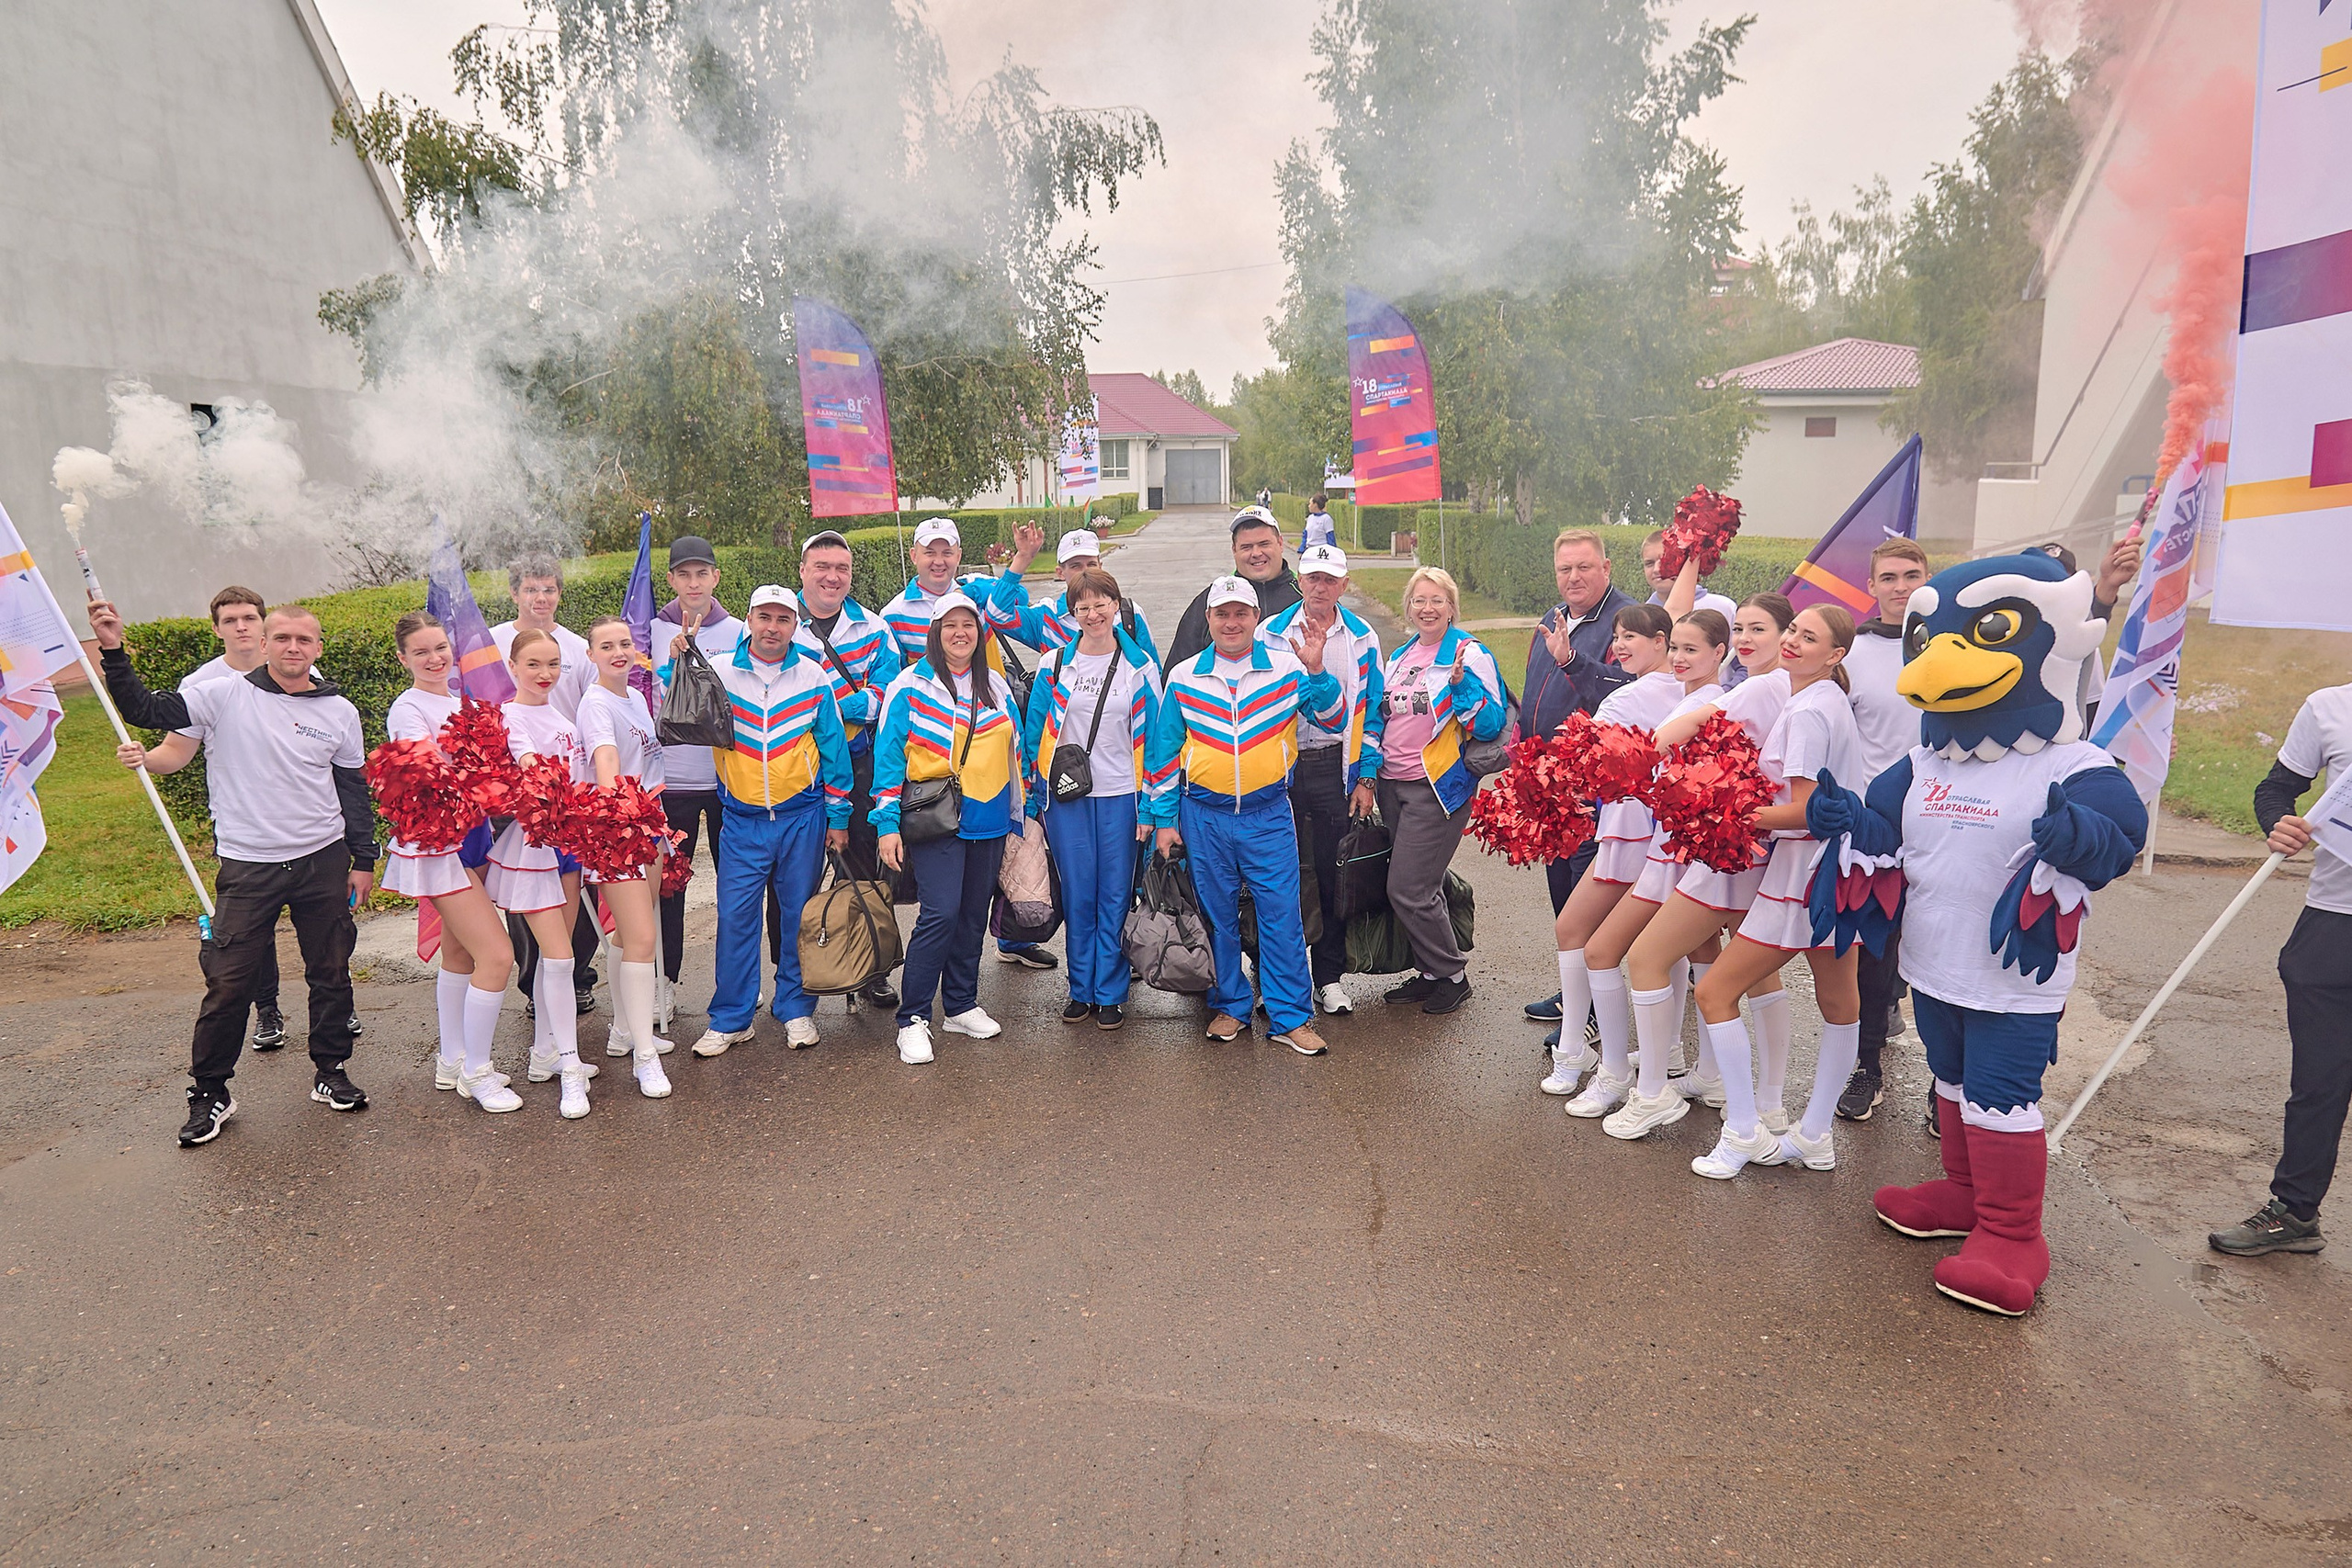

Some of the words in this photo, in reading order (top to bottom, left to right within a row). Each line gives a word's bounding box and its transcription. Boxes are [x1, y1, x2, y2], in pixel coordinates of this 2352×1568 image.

[1363, 378, 1377, 394] 18
[1317, 547, 1329, 560] LA
[1057, 781, 1080, 795] adidas
[1946, 795, 1991, 806] ОТРАСЛЕВАЯ
[1925, 803, 1999, 818] СПАРТАКИАДА
